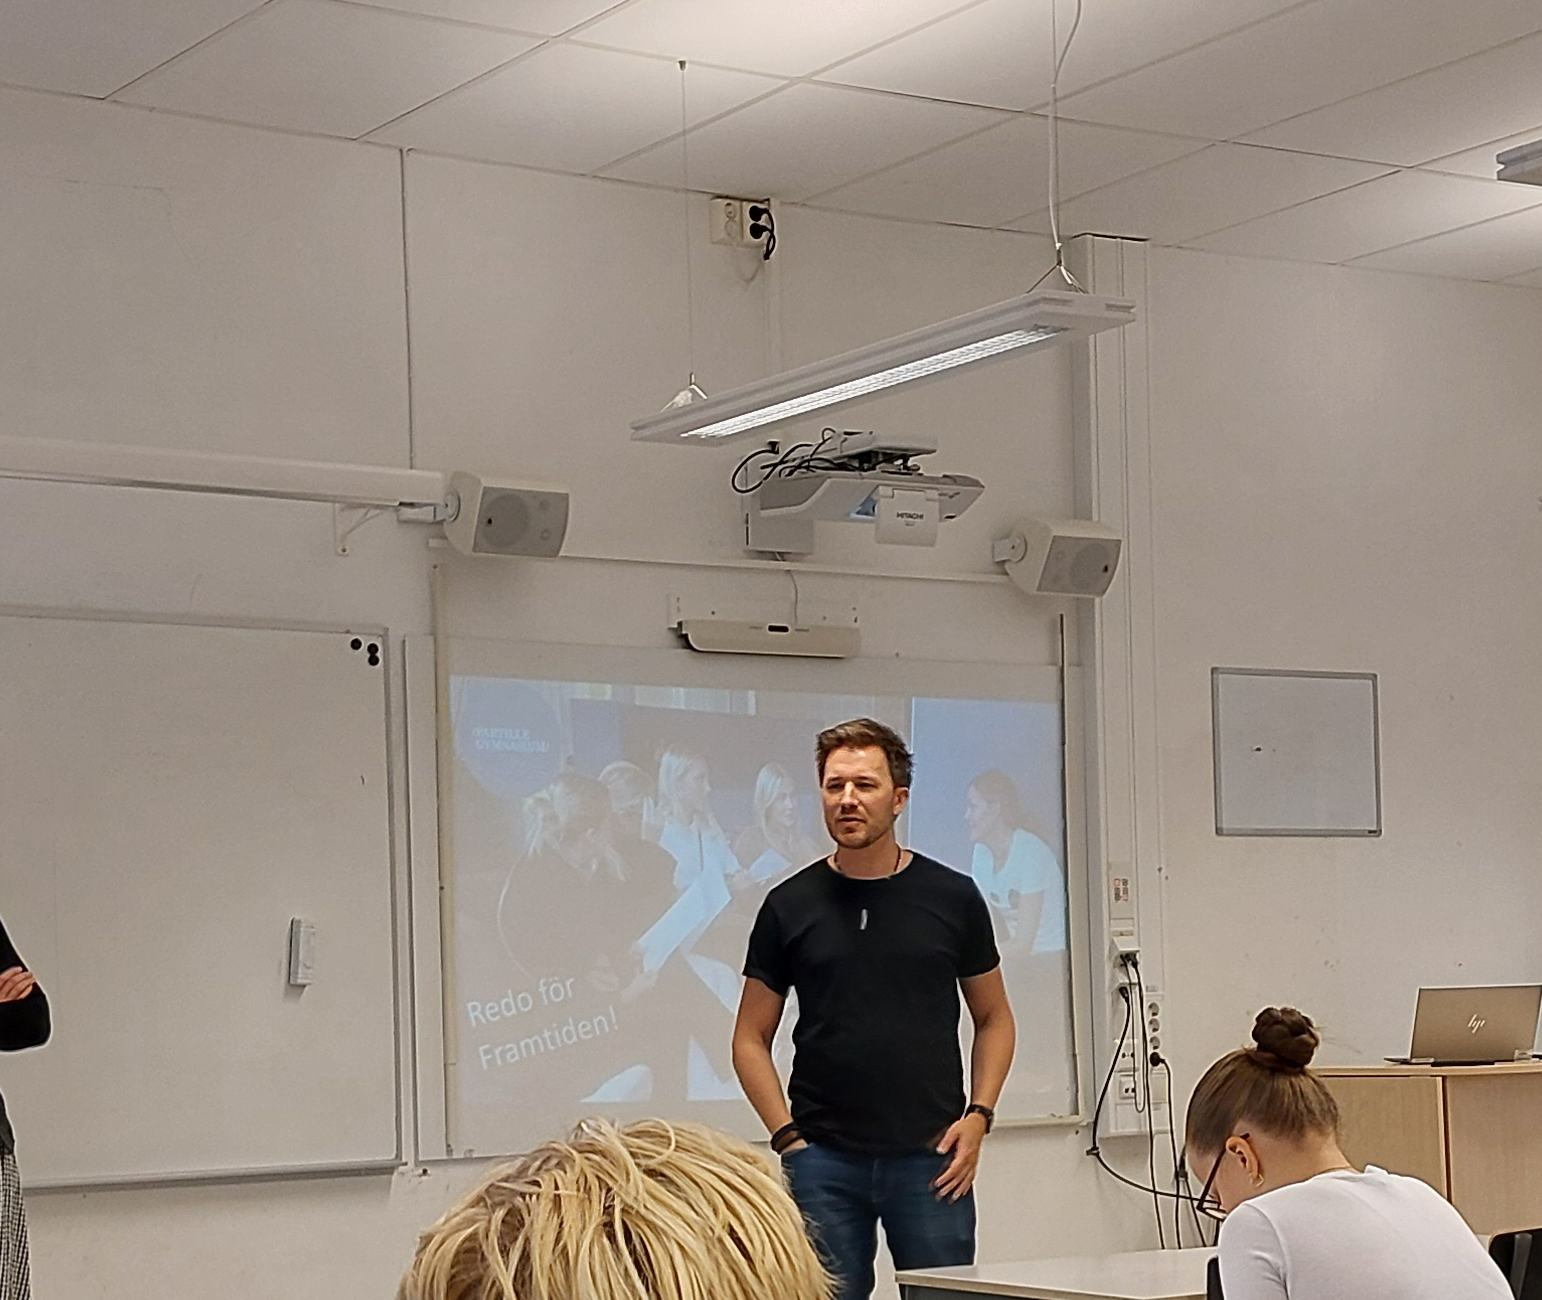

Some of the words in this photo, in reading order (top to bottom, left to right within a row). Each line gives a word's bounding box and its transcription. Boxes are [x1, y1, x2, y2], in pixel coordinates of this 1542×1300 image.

[897, 512, 924, 520] HITACHI
[466, 990, 534, 1028] Redo
[538, 974, 576, 1007] för
[477, 1005, 620, 1071] Framtiden!
[1467, 1013, 1486, 1034] hp
